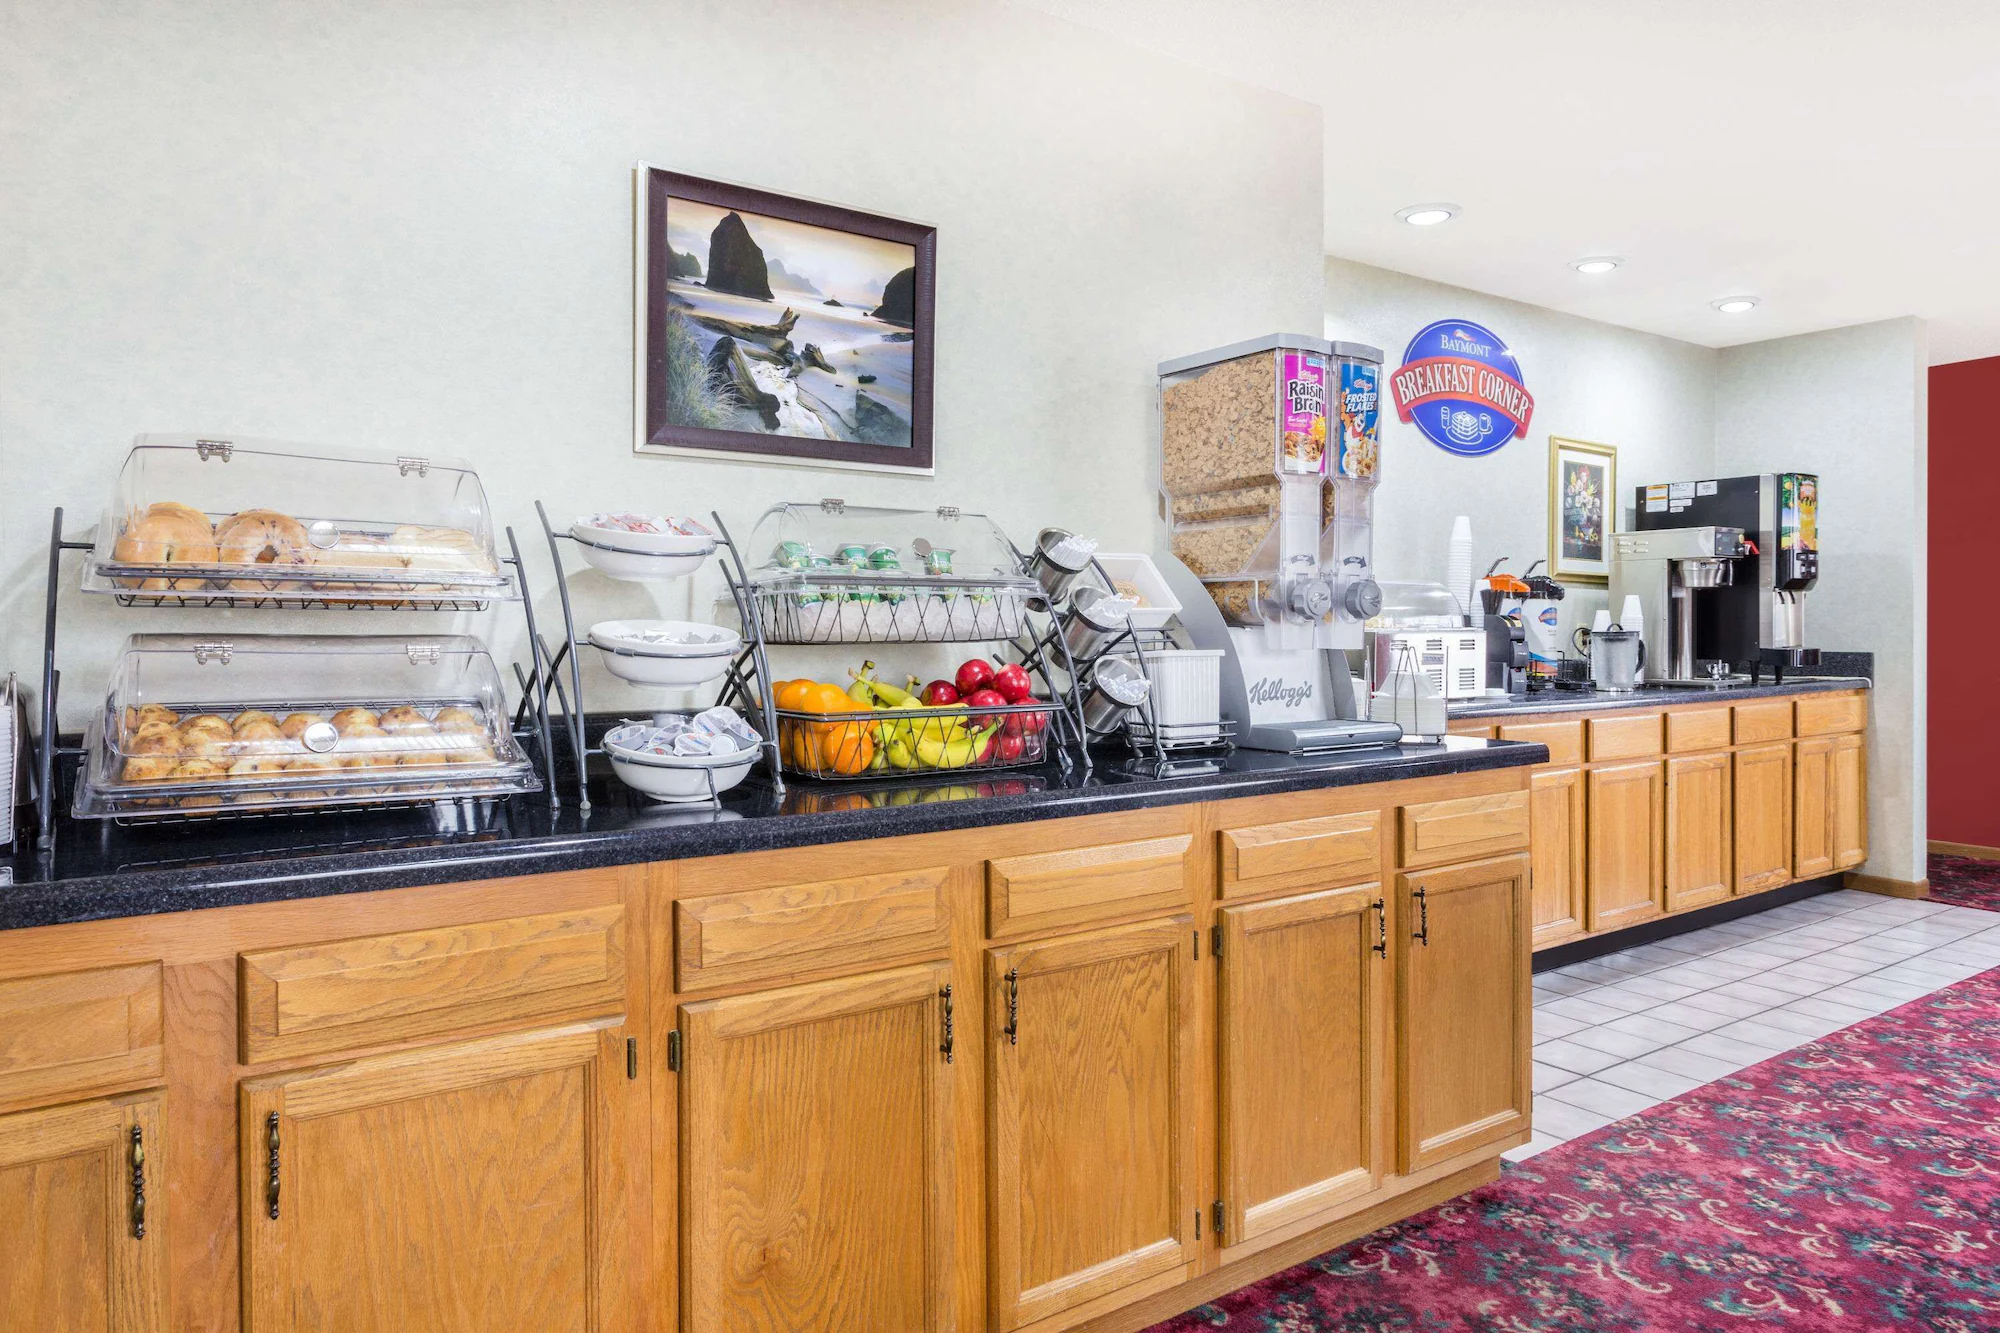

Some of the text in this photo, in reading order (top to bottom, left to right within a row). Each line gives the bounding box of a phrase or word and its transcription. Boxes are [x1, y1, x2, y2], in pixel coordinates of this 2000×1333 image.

[1440, 334, 1491, 357] BAYMONT
[1289, 381, 1323, 401] Raisin
[1346, 393, 1376, 403] FROSTED
[1396, 363, 1529, 423] BREAKFAST CORNER
[1294, 397, 1321, 415] Bran
[1346, 401, 1374, 412] FLAKES
[1249, 677, 1312, 707] Kellogg's
